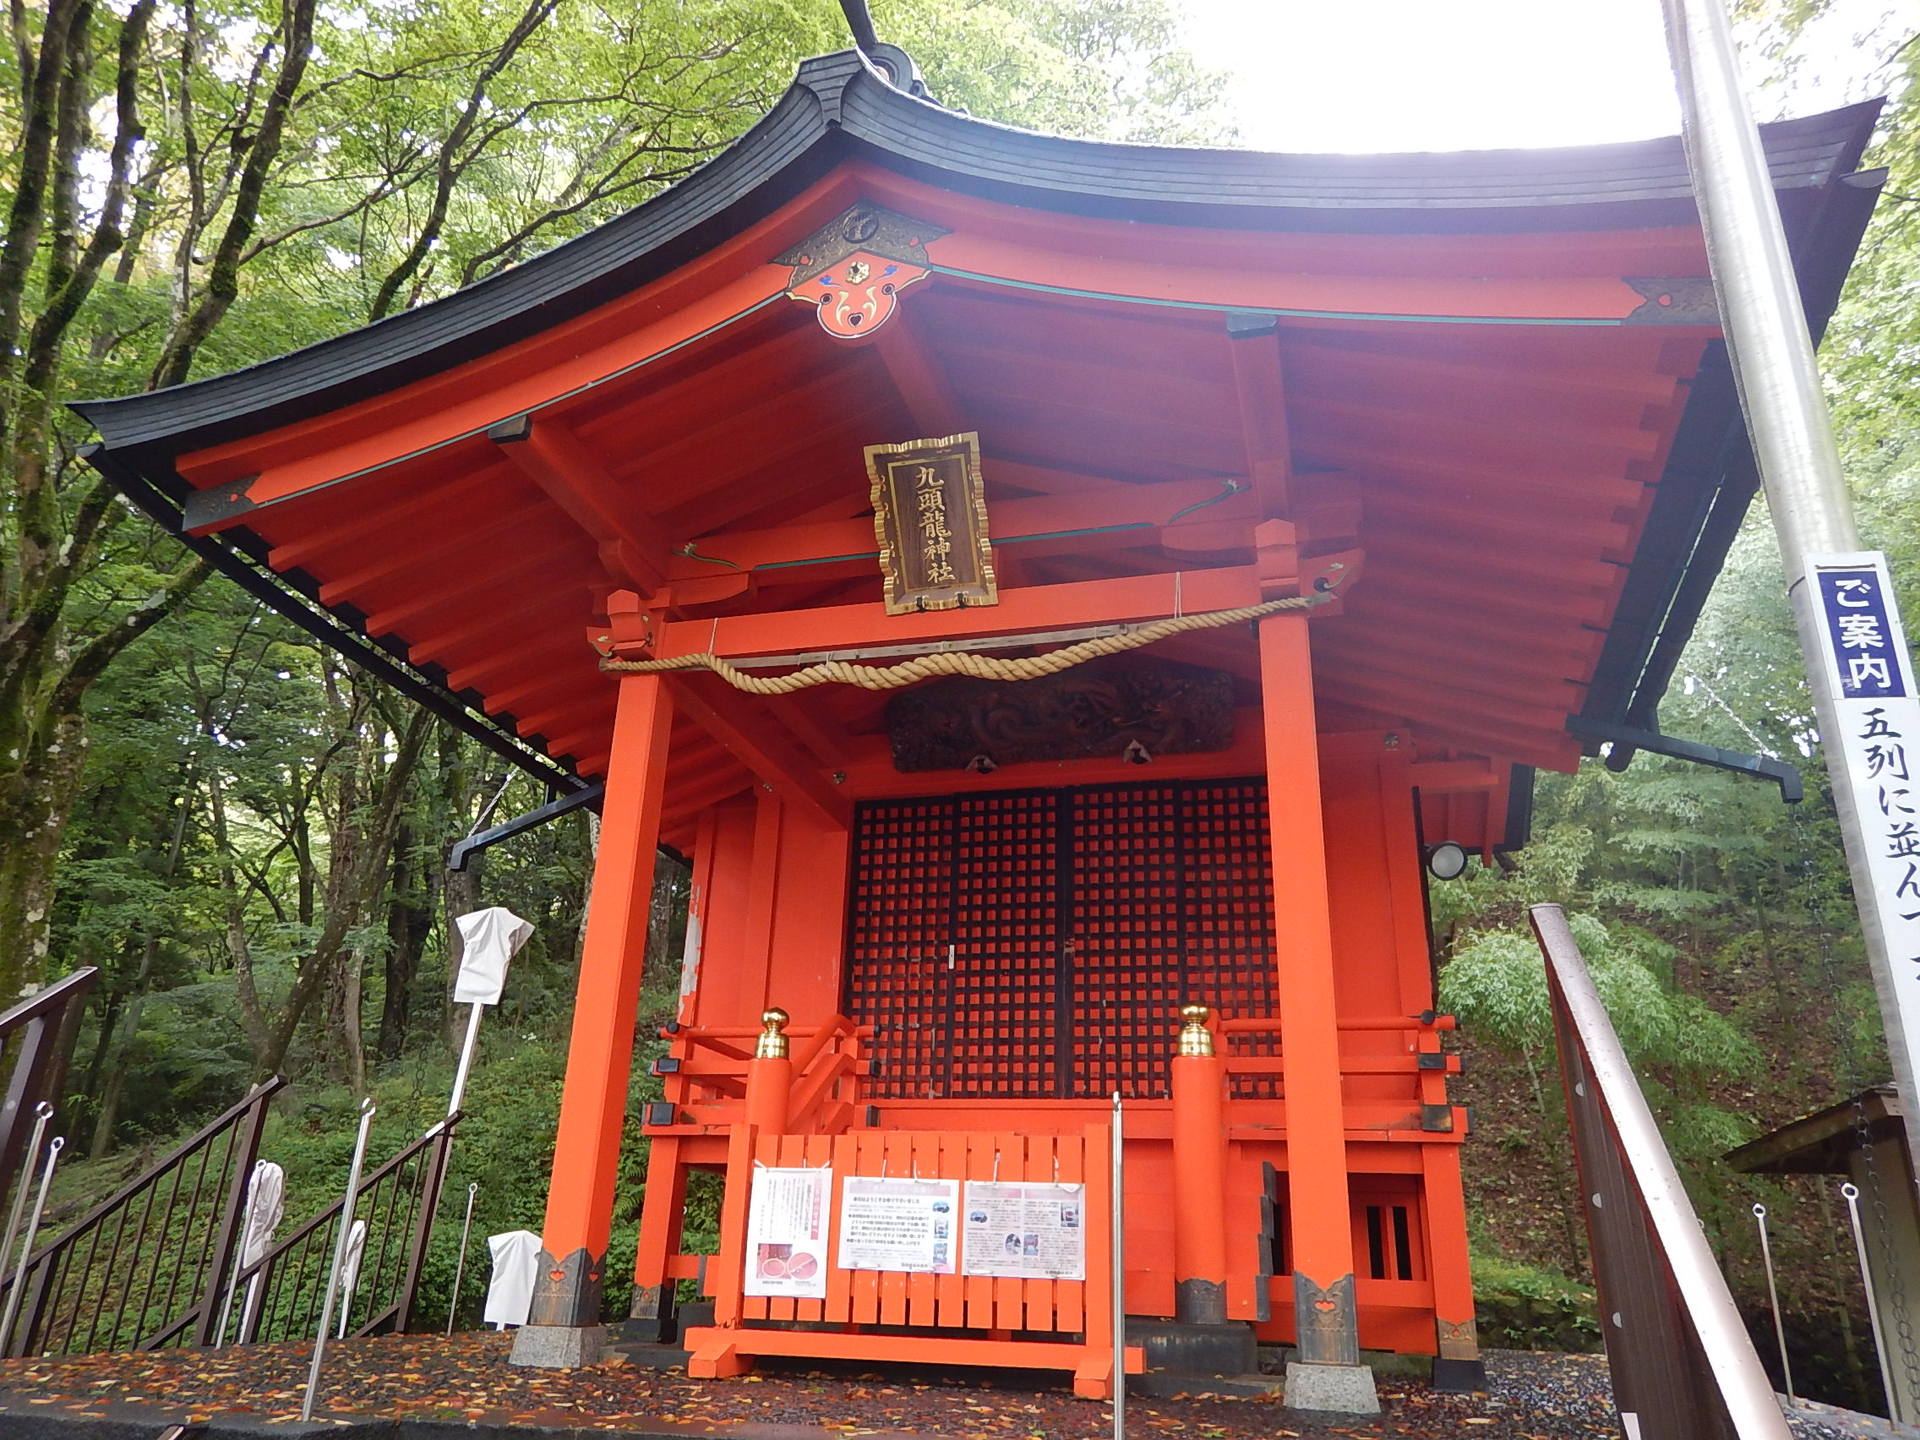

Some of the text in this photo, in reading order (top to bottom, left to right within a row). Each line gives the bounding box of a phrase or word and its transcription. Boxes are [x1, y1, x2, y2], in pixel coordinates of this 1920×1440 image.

[914, 466, 957, 584] 九頭龍神社
[1834, 579, 1891, 689] ご案内
